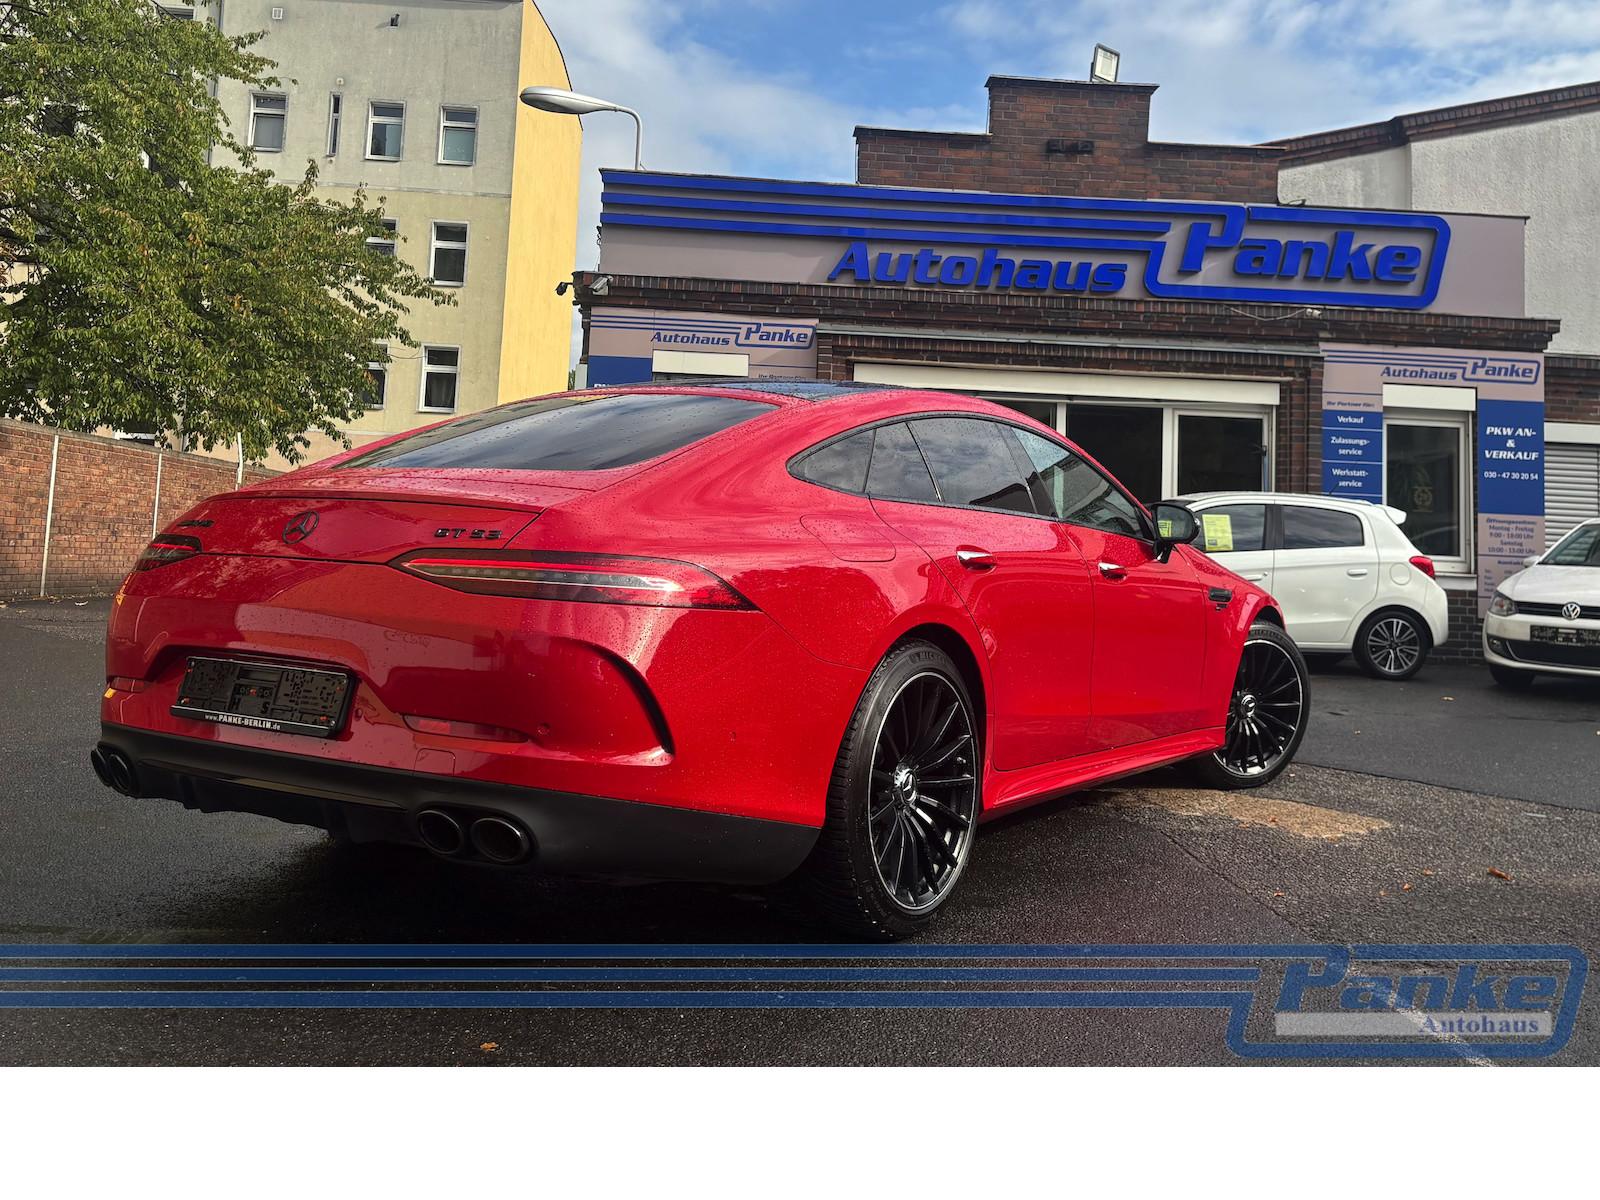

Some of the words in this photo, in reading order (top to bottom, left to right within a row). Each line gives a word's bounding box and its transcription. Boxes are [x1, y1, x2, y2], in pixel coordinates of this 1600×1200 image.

[827, 241, 1128, 293] Autohaus
[1177, 206, 1425, 283] Panke
[651, 331, 731, 346] Autohaus
[745, 323, 809, 343] Panke
[1381, 366, 1457, 380] Autohaus
[1471, 358, 1533, 378] Panke
[1337, 415, 1364, 424] Verkauf
[1486, 426, 1514, 436] PKW
[1514, 428, 1537, 437] AN-
[1330, 436, 1371, 446] Zulassungs-
[1506, 439, 1516, 448] &
[1338, 448, 1363, 456] service
[1484, 450, 1540, 461] VERKAUF
[1331, 468, 1369, 477] Werkstatt-
[1483, 471, 1497, 479] 030
[1511, 472, 1520, 480] 30
[1530, 473, 1539, 481] 54
[1338, 480, 1363, 488] service
[434, 528, 467, 539] GT
[204, 713, 281, 731] www.PANKE-BERLIN.de
